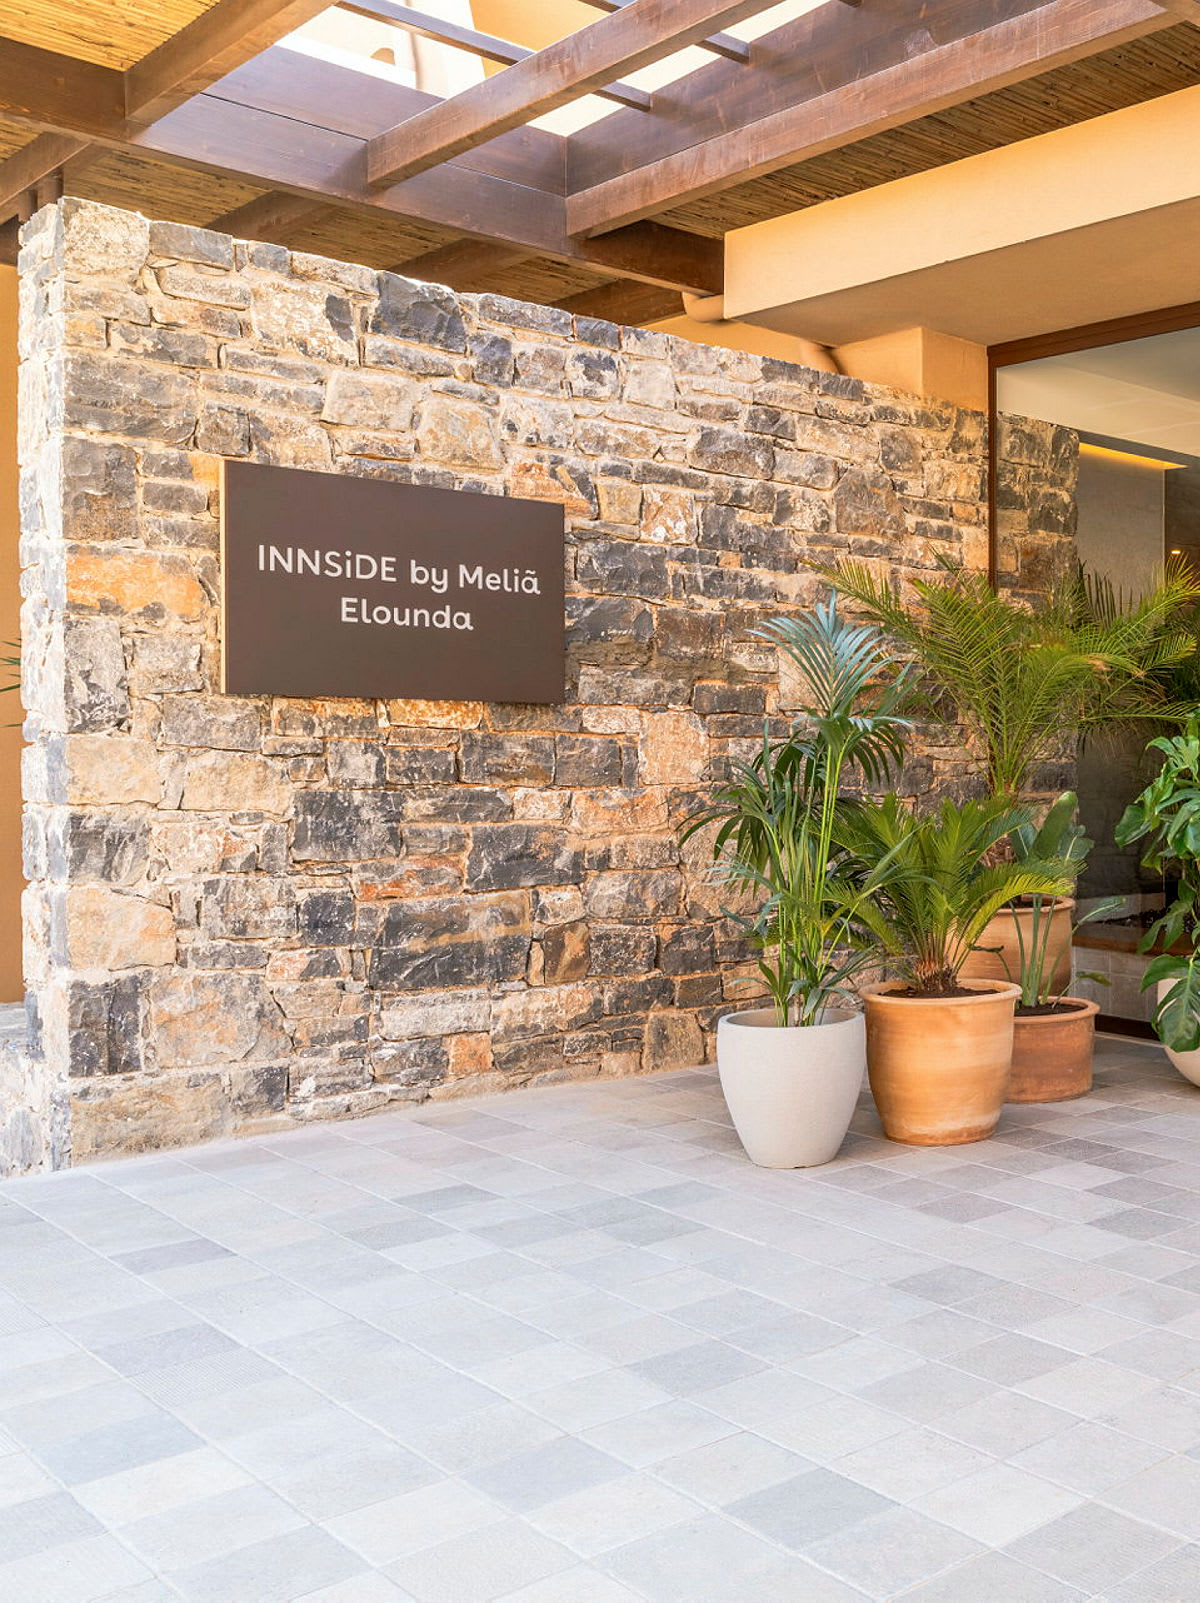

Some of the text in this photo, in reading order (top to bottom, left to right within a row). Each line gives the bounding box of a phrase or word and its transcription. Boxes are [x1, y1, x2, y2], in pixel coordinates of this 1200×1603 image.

[257, 543, 398, 583] INNSiDE
[409, 559, 449, 594] by
[340, 596, 474, 631] Elounda
